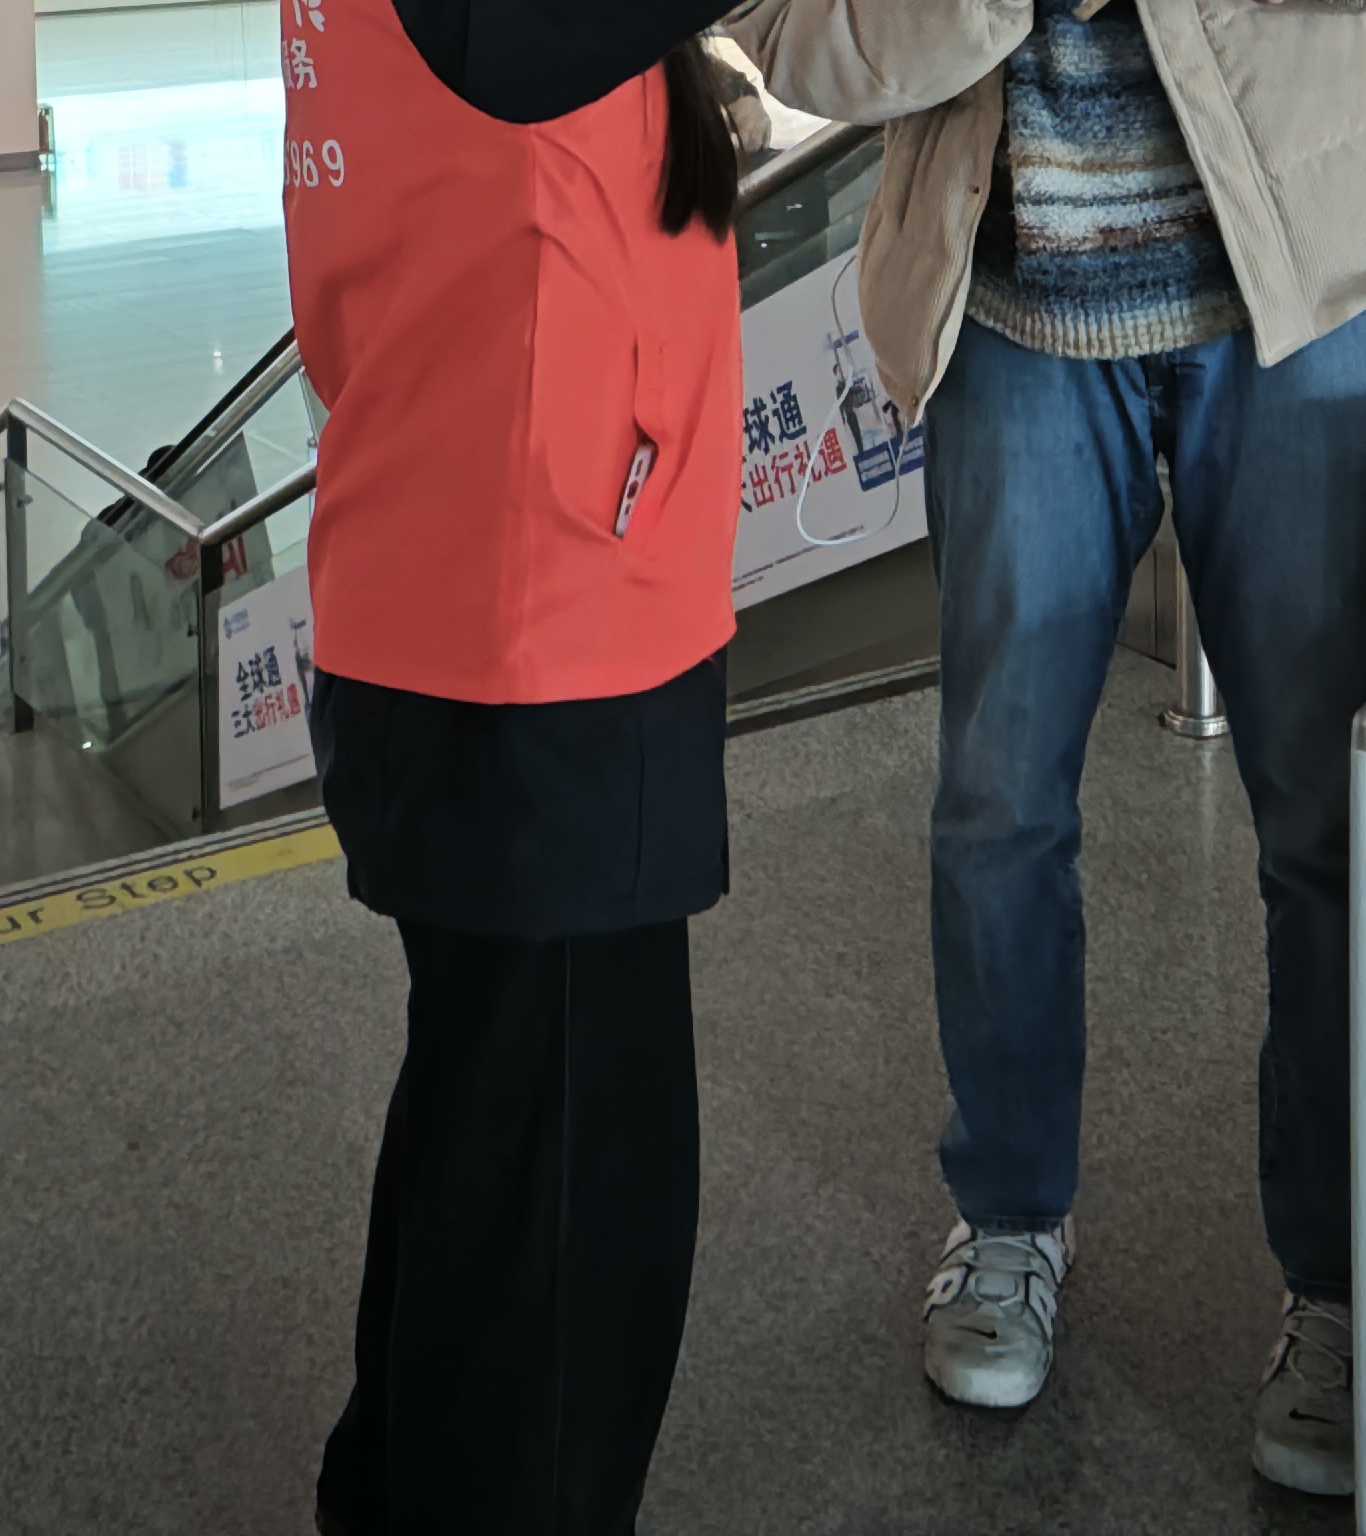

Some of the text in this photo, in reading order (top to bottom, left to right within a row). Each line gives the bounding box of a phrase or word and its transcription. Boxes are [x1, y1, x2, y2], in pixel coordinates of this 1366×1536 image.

[741, 426, 848, 513] 出行礼遇
[235, 645, 282, 702] 全球通
[75, 862, 219, 911] Step
